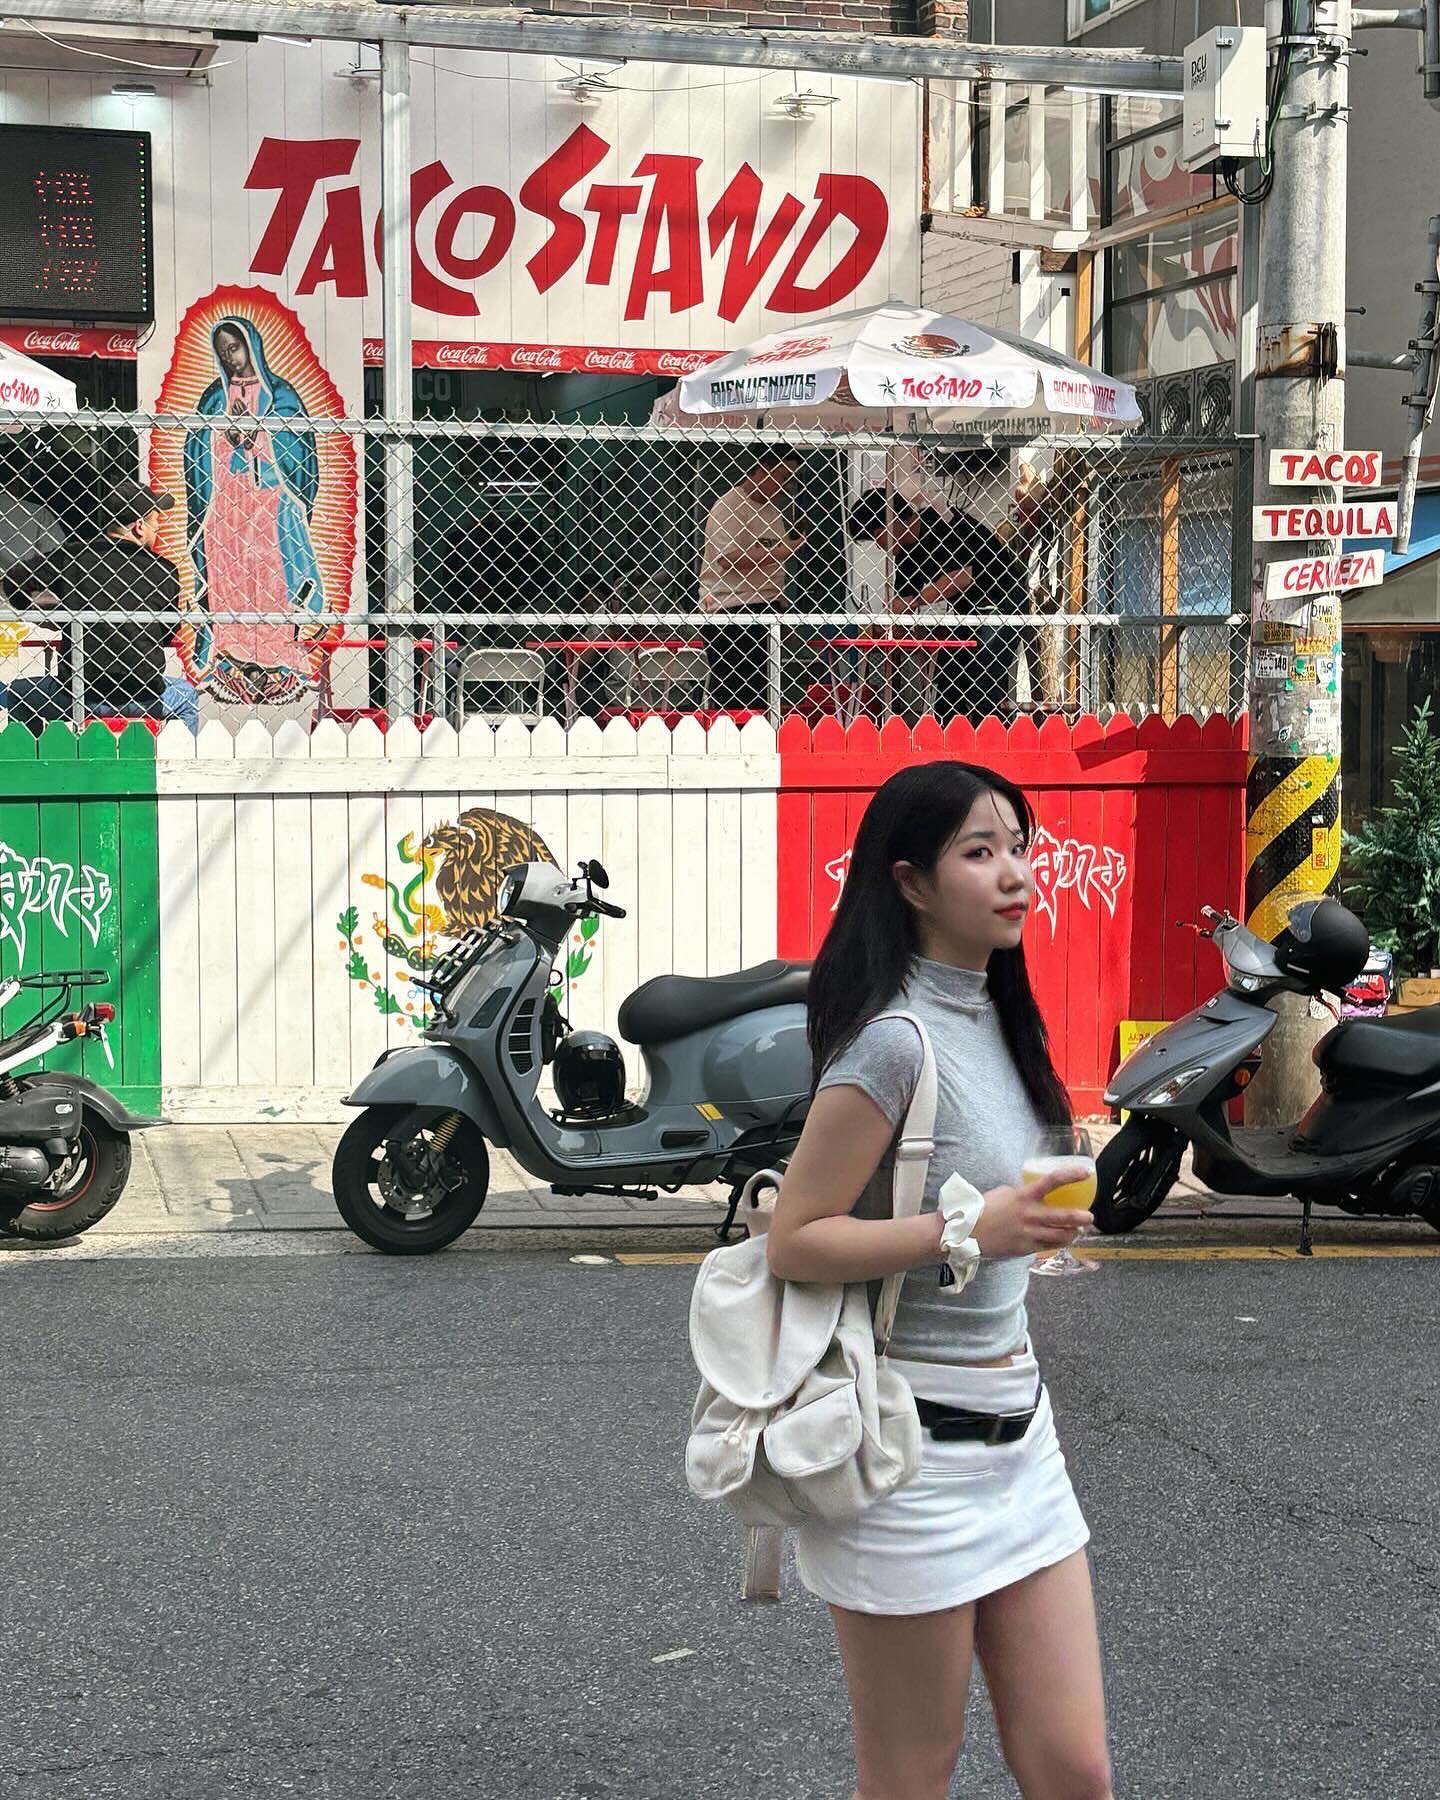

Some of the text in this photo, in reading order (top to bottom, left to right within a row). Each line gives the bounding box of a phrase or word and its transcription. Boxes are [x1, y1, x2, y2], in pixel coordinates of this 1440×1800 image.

[1191, 53, 1207, 77] DCU
[436, 345, 489, 364] Coca-Cola
[511, 347, 562, 367] Coca-Cola
[585, 351, 637, 369] Coca-Cola
[1280, 453, 1379, 485] TACOS
[1262, 507, 1393, 537] TEQUILA
[1283, 555, 1376, 592] CERVEZA
[1315, 831, 1326, 867] 위험
